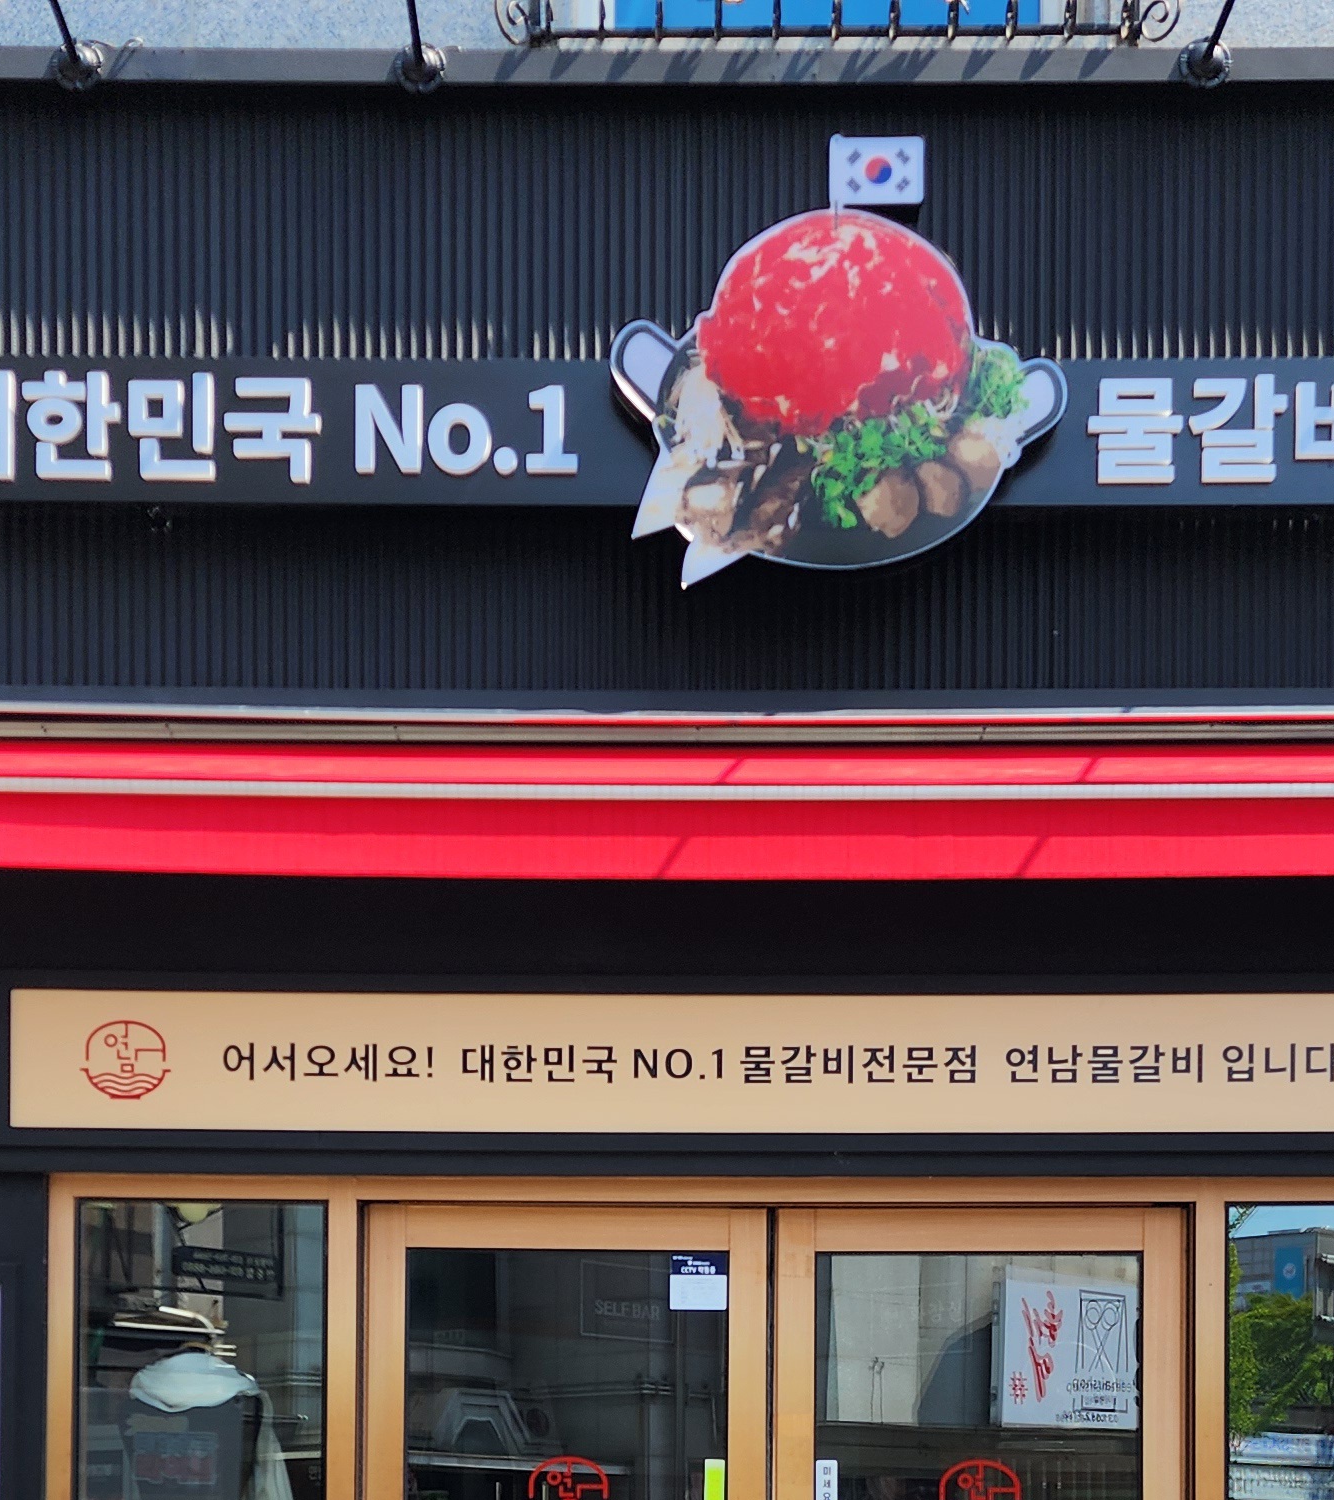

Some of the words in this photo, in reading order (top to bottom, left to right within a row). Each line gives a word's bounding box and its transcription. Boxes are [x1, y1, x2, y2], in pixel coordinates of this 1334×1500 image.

[353, 382, 579, 477] No.1
[221, 1041, 434, 1083] 어서오세요!
[461, 1043, 619, 1085] 대한민국
[632, 1047, 728, 1082] NO.1
[739, 1043, 979, 1086] 물갈비전문점
[1005, 1042, 1206, 1086] 연남물갈비
